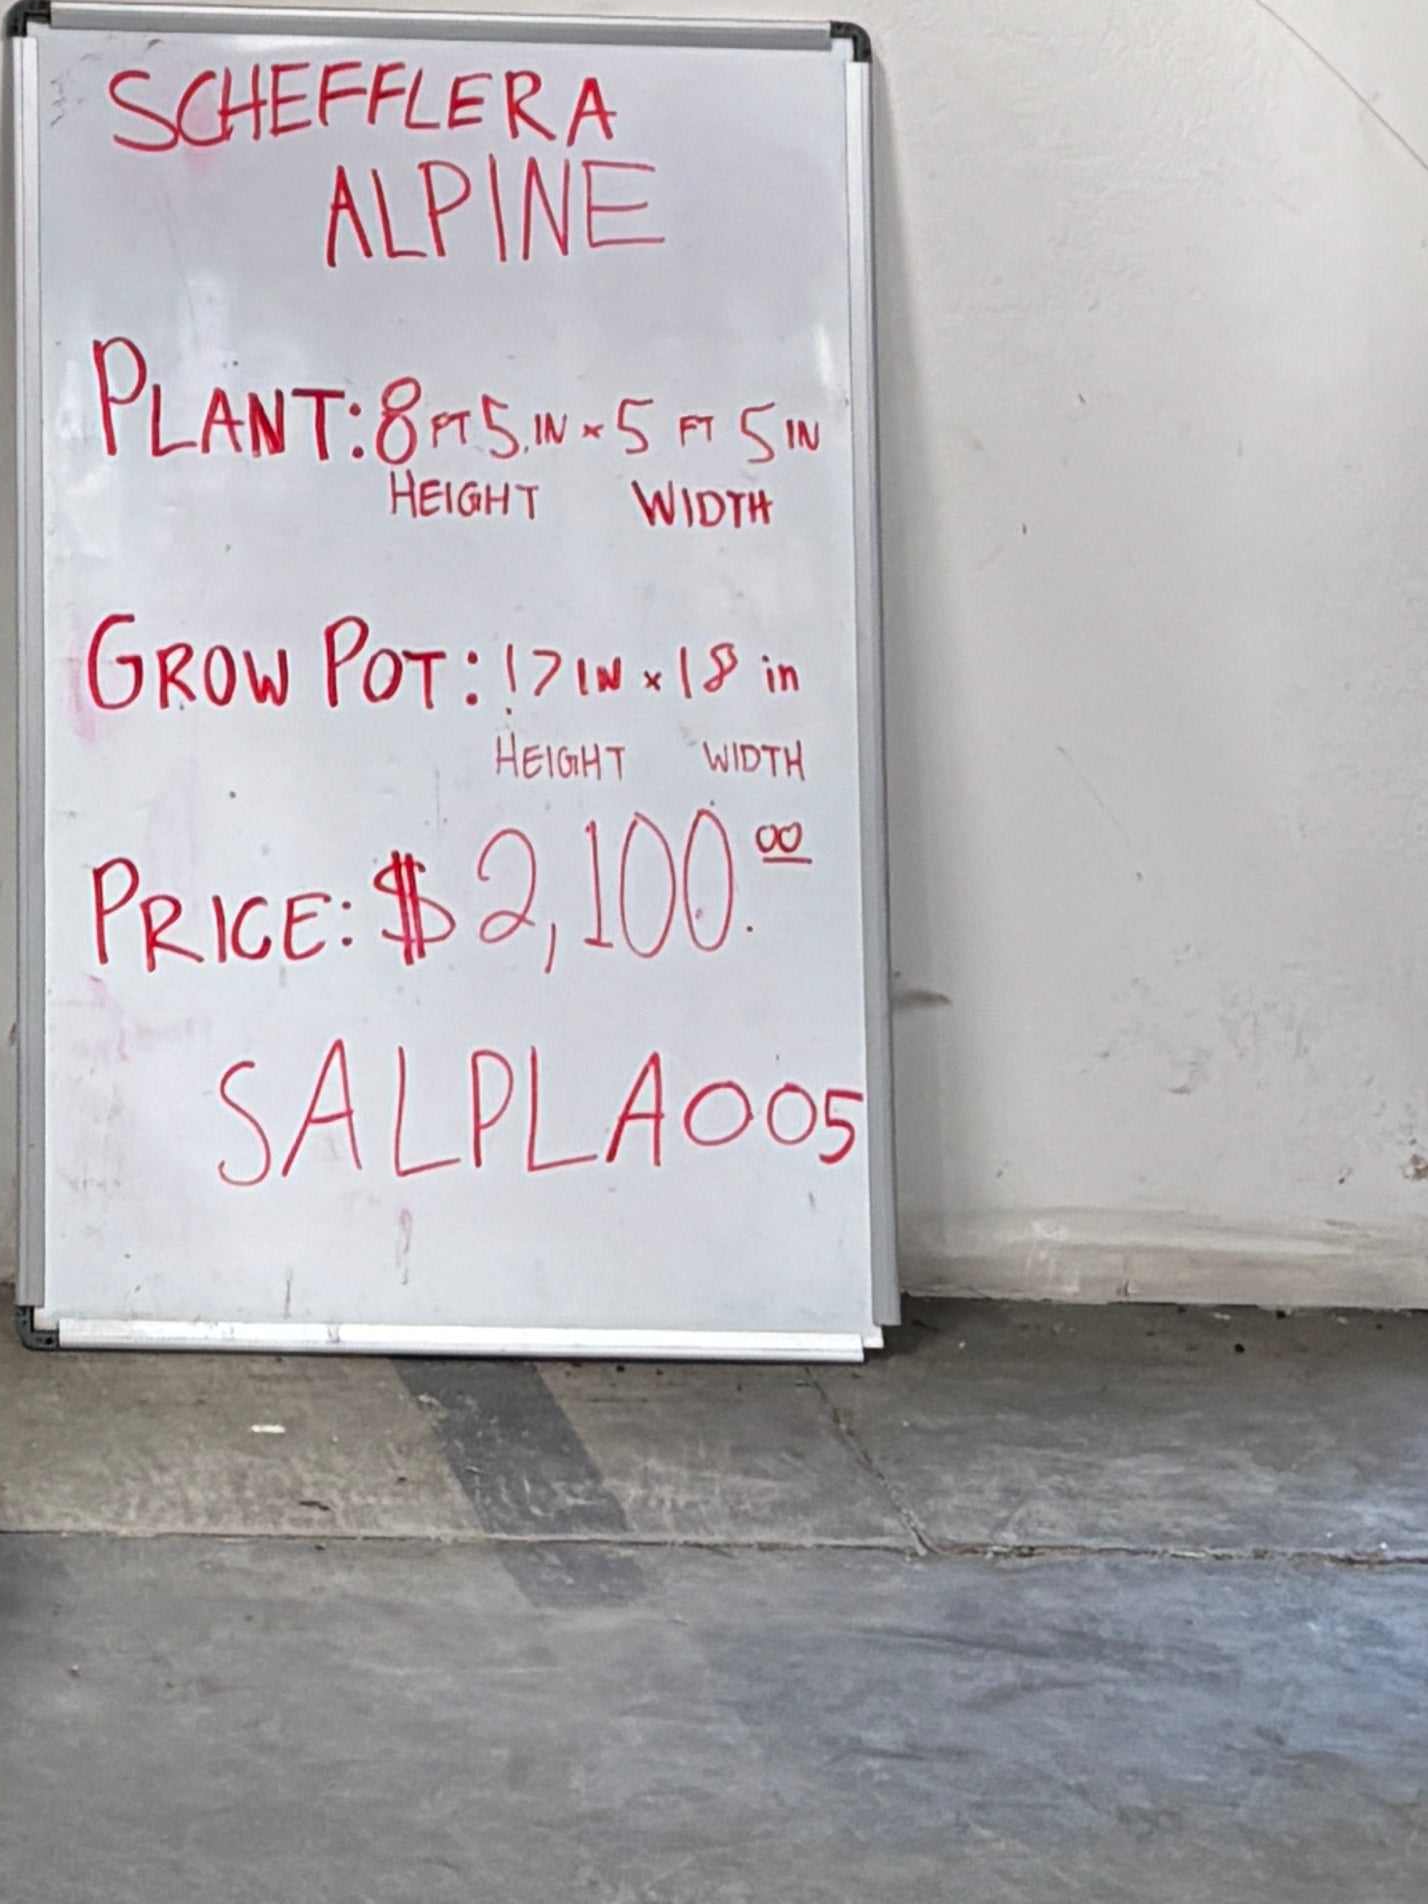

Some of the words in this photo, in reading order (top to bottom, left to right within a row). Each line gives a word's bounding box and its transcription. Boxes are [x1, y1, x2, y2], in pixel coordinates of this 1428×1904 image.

[108, 60, 617, 154] SCHEFFLERA
[324, 154, 666, 269] ALPINE
[91, 336, 365, 463] PLANT:
[373, 375, 423, 467] 8
[616, 397, 654, 456] 5
[678, 414, 715, 448] FT
[739, 402, 776, 465] 5
[785, 418, 821, 452] IN
[389, 470, 539, 520] HEIGHT
[630, 480, 775, 529] WIDTH
[84, 613, 290, 712] GROW
[321, 615, 480, 710] POT:
[677, 642, 740, 699] 18
[761, 654, 800, 694] in
[494, 730, 627, 782] HEIGHT
[701, 739, 807, 782] WIDTH
[91, 856, 353, 973] PRICE:
